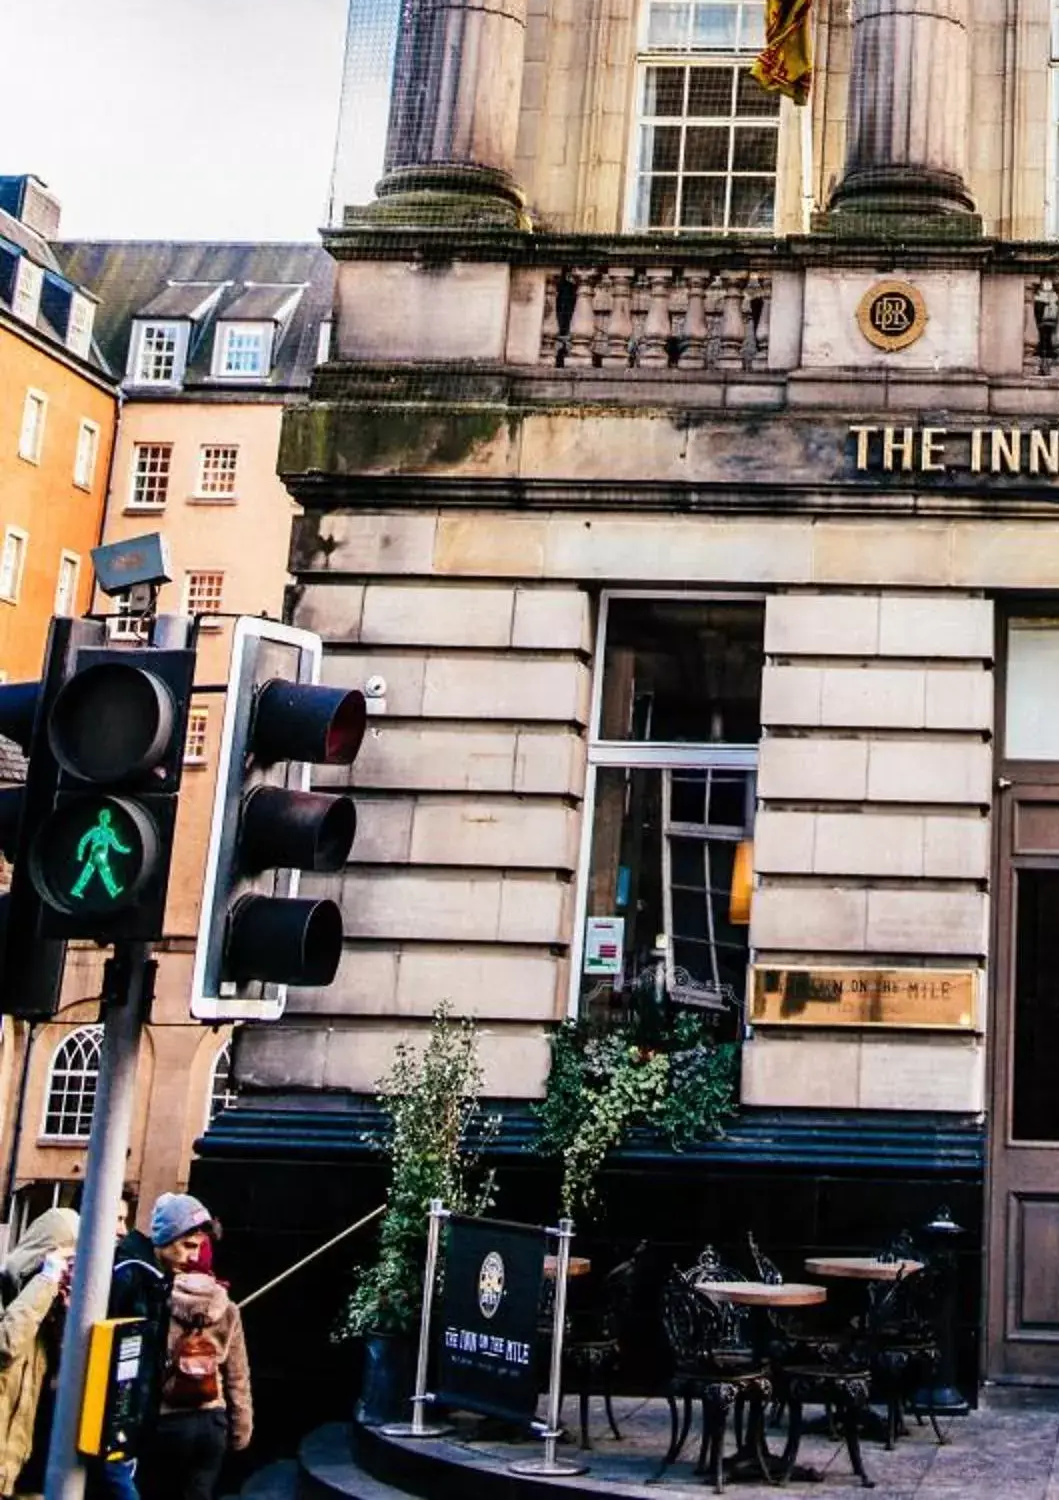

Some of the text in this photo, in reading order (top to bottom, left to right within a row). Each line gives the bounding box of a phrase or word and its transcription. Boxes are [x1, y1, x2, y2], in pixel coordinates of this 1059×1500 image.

[850, 426, 946, 472] THE
[971, 429, 1059, 475] INN
[506, 1340, 531, 1364] MILE
